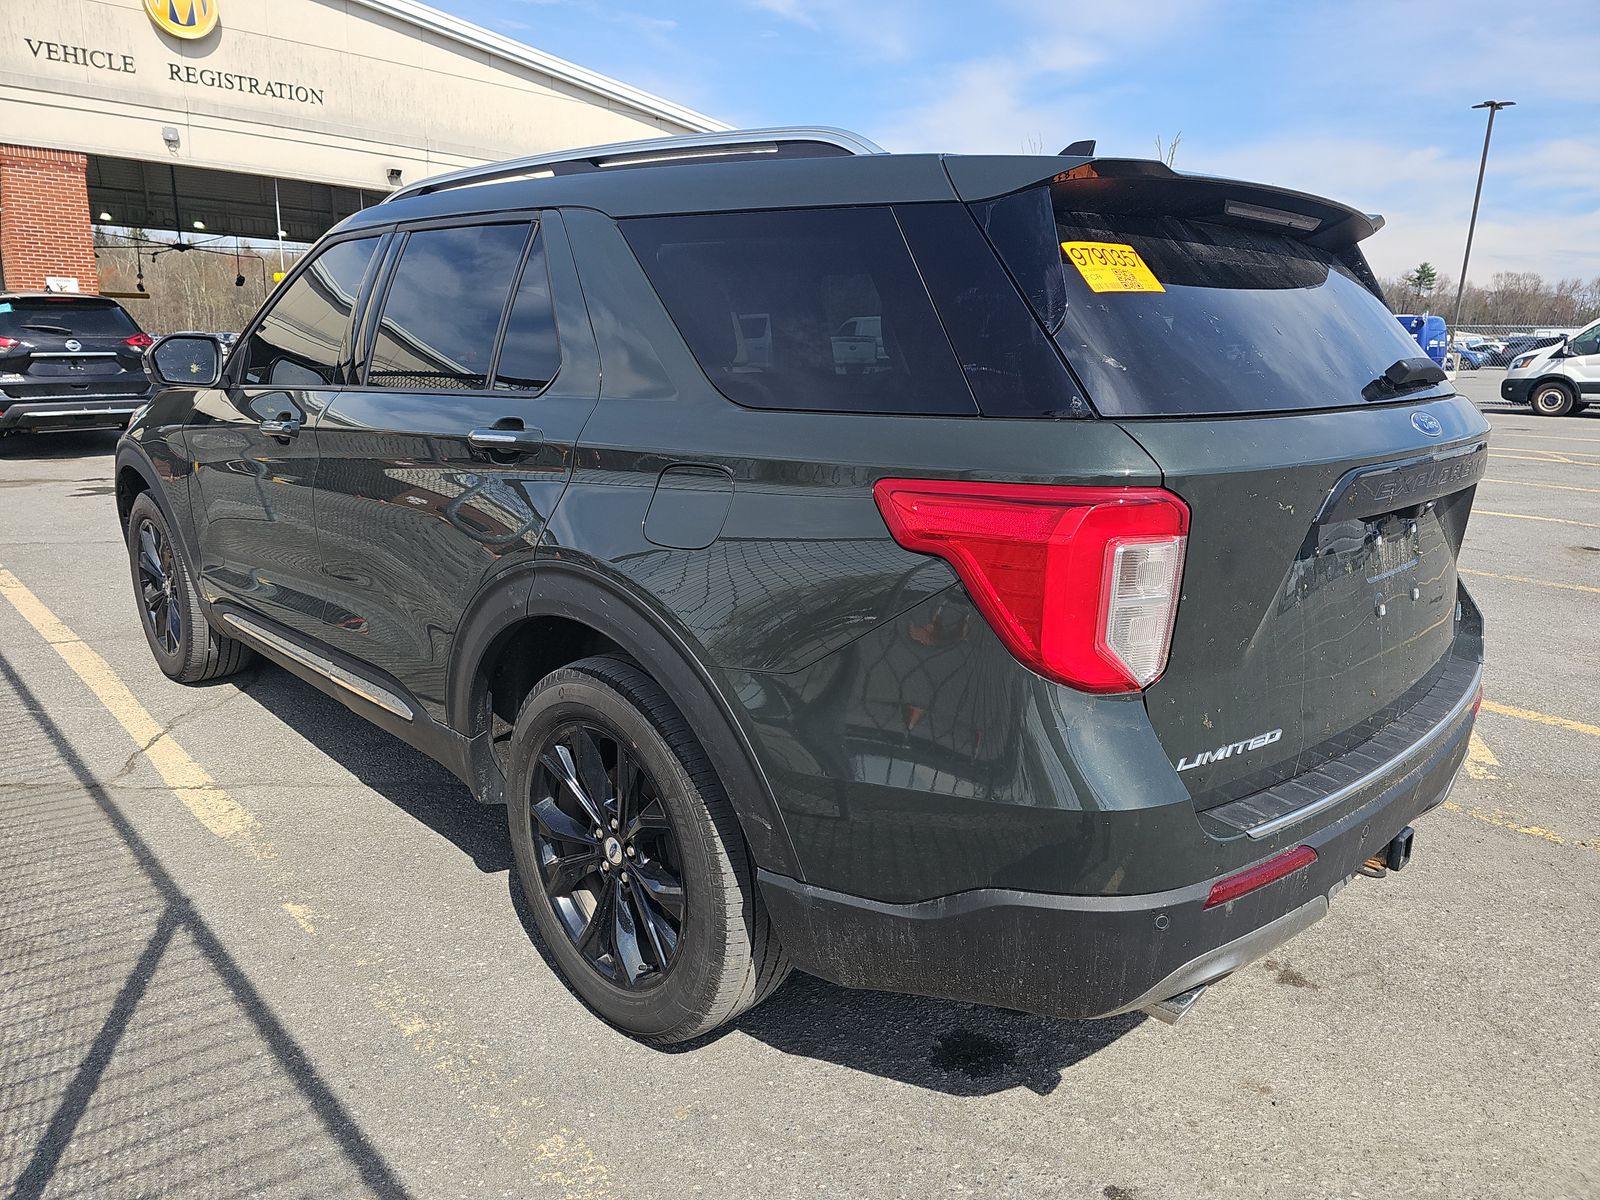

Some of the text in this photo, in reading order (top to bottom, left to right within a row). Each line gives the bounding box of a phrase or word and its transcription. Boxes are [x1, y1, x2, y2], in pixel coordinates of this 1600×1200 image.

[24, 38, 324, 105] VEHICLE REGISTRATION
[1070, 247, 1143, 268] 9790357
[1176, 728, 1283, 772] LIMITED
